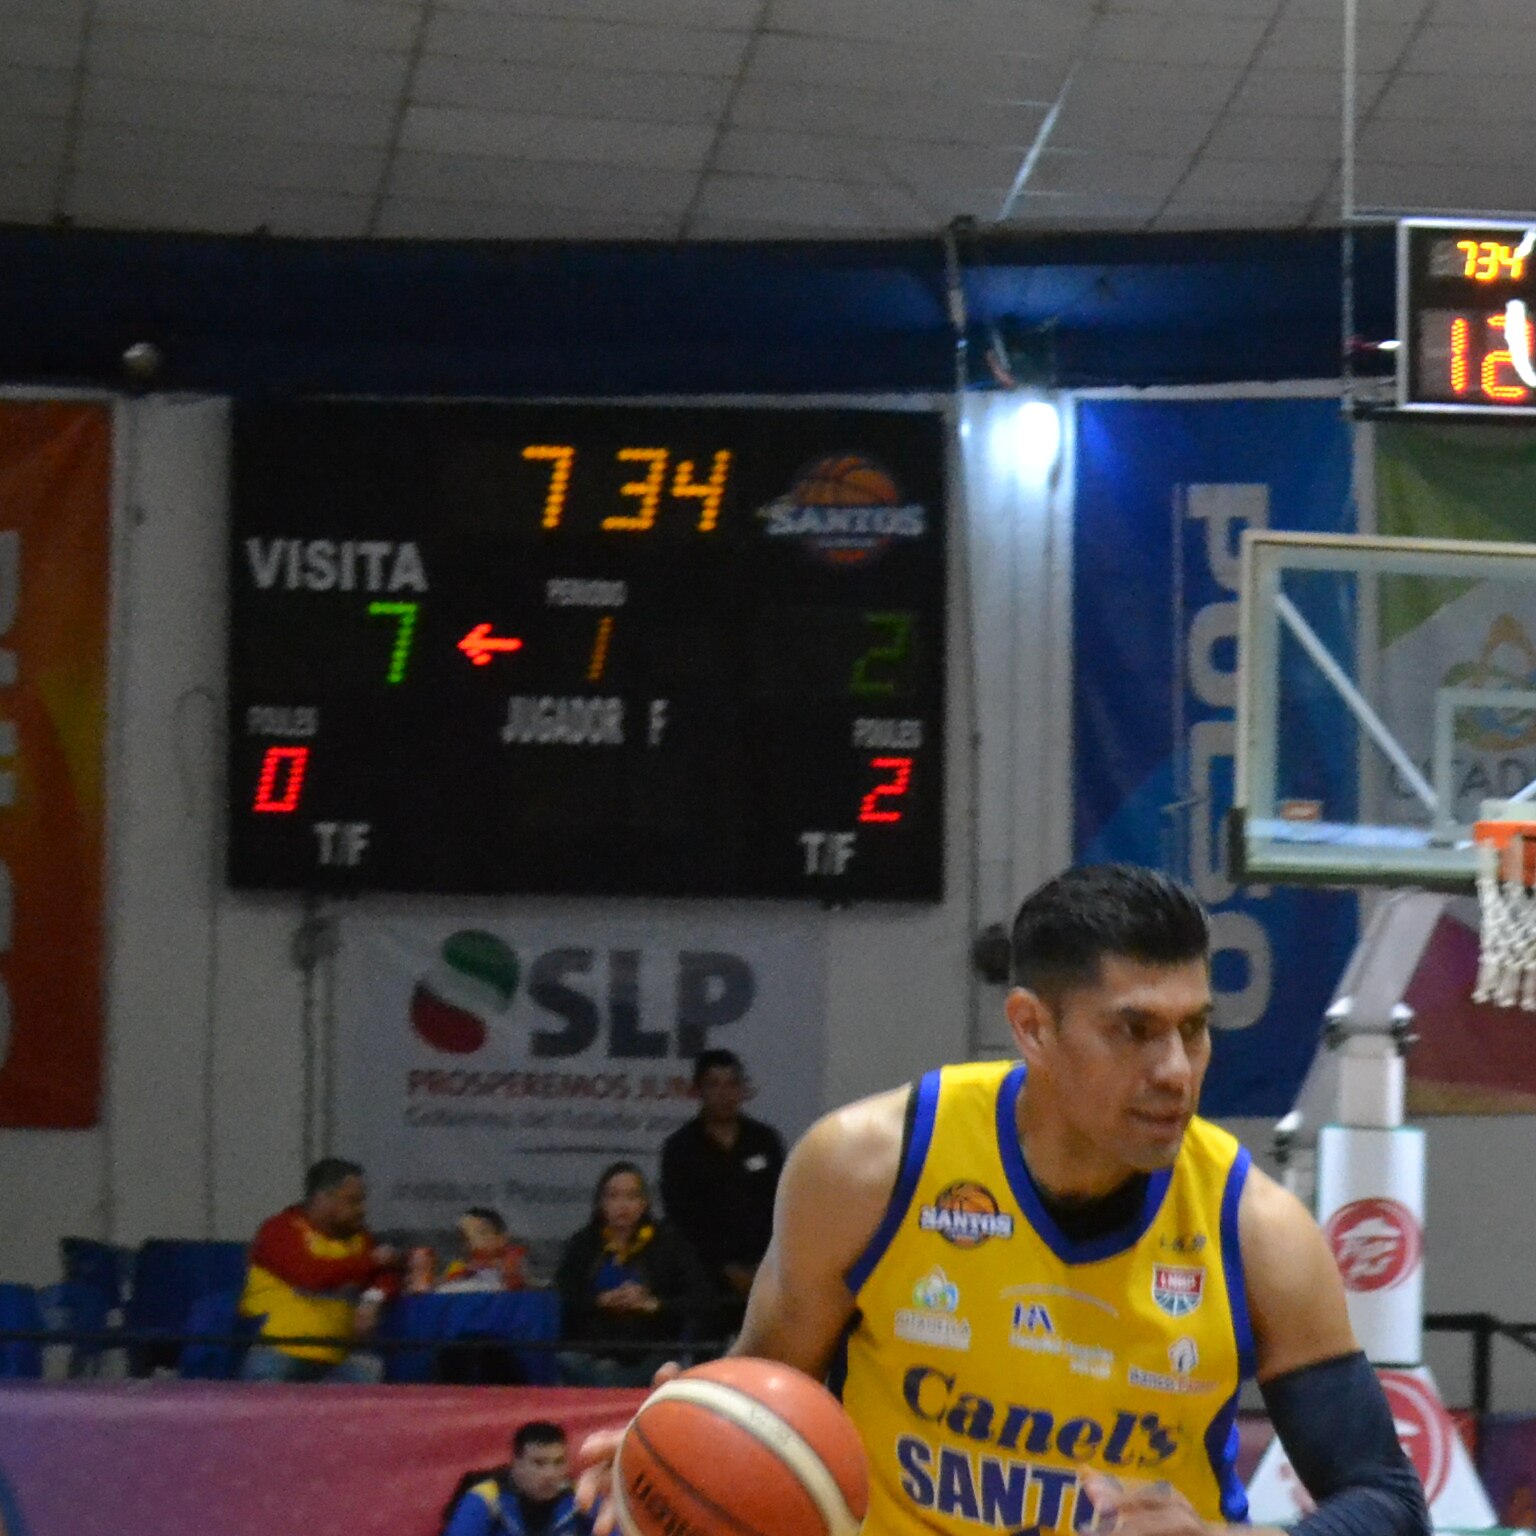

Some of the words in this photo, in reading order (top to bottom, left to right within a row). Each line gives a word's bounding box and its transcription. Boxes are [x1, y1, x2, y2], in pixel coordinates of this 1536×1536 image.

[763, 502, 926, 537] SANTOS
[245, 535, 429, 593] VISITA
[366, 601, 419, 685] 7
[584, 615, 616, 682] 1
[850, 611, 912, 693] 2
[501, 695, 626, 745] JUGADOR
[648, 698, 670, 746] F
[252, 745, 310, 814] 0
[857, 756, 914, 824] 2
[527, 947, 757, 1060] SLP
[919, 1206, 1014, 1239] SANTOS
[901, 1364, 1180, 1468] Canel's
